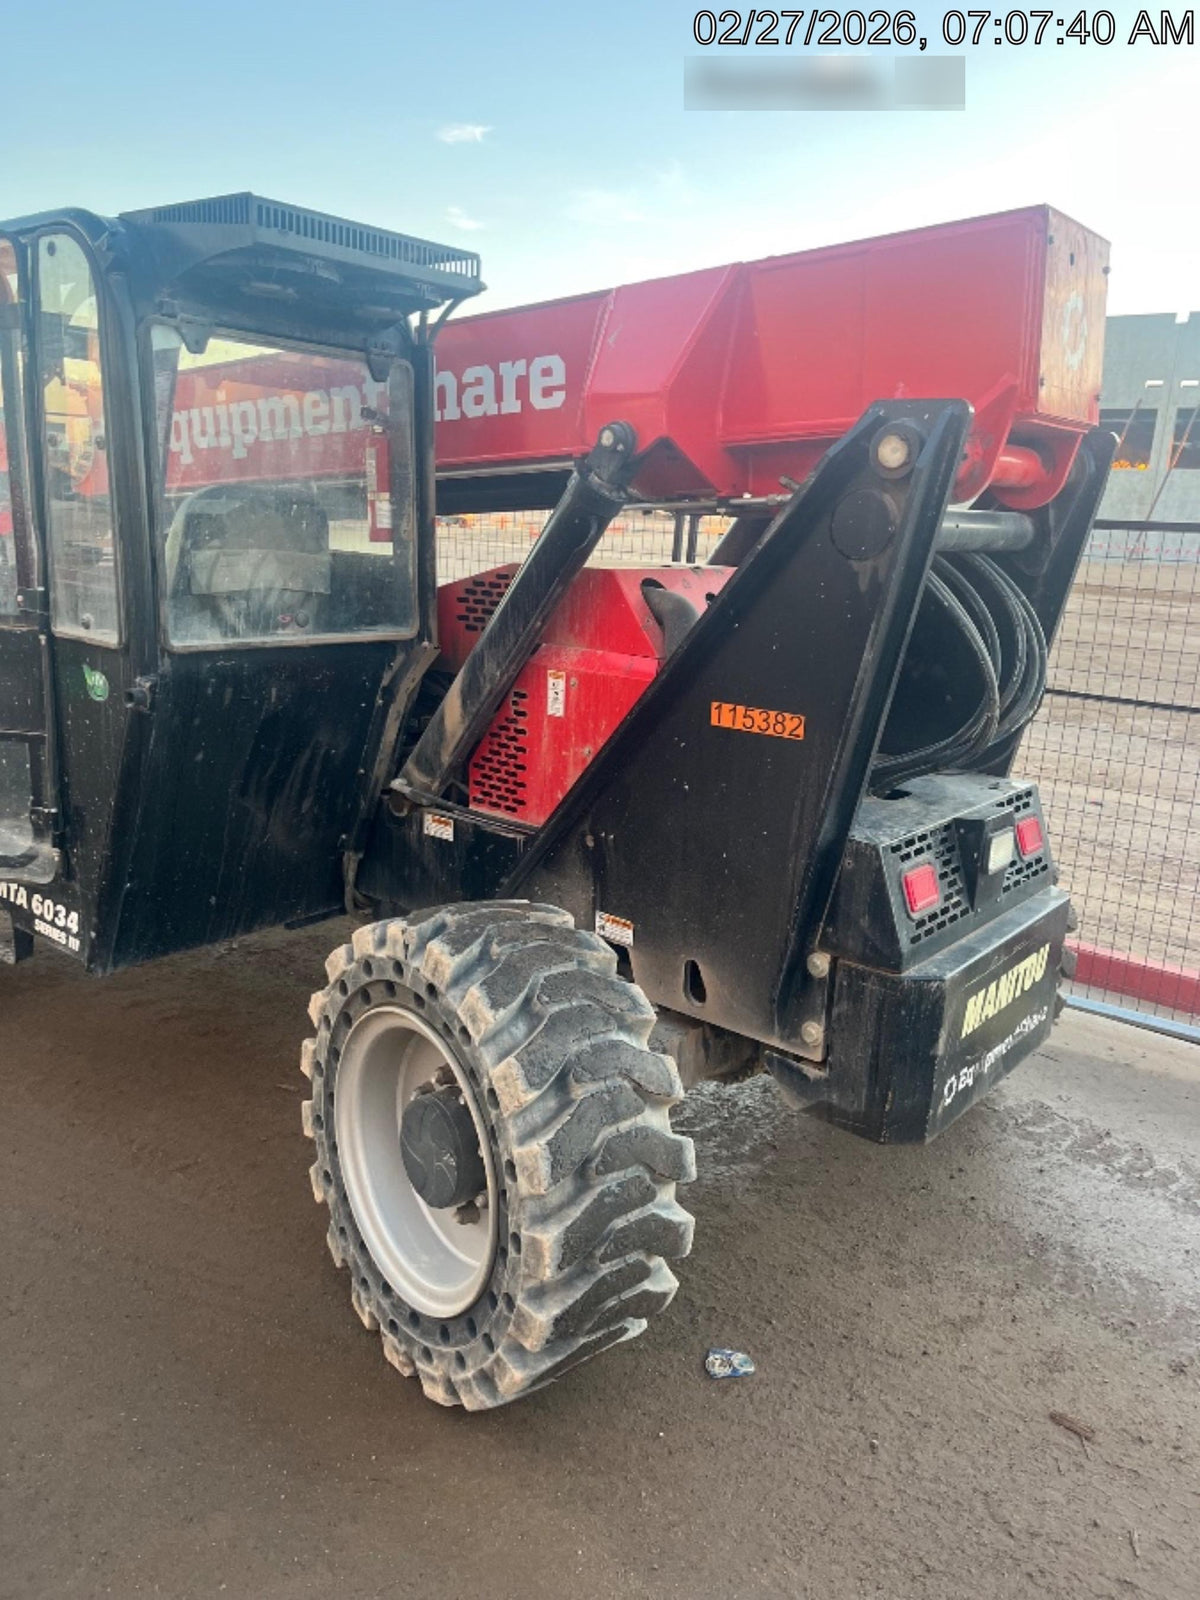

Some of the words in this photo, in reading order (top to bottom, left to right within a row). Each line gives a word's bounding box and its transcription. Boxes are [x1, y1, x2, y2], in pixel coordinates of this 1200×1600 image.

[714, 703, 803, 738] 115382
[31, 893, 79, 934] 6034
[34, 918, 67, 944] SERIES
[961, 943, 1051, 1039] MANITOU
